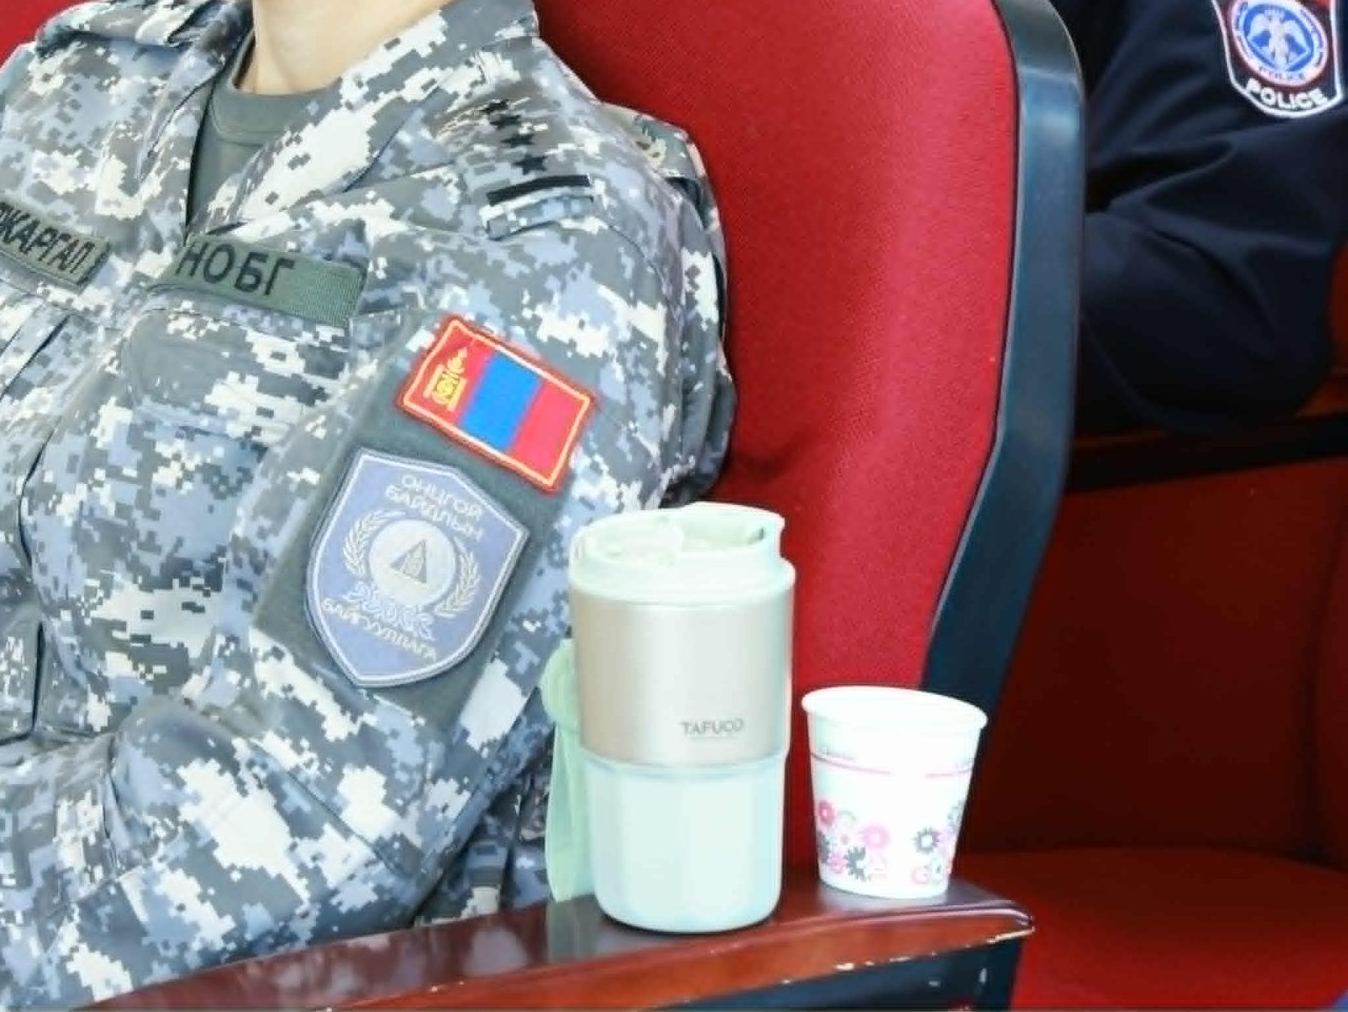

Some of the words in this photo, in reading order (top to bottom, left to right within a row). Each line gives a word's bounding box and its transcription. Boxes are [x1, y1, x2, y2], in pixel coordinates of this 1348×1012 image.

[1245, 77, 1329, 110] POLICE
[174, 240, 296, 297] НОБГ
[679, 717, 744, 736] TAFUCO
